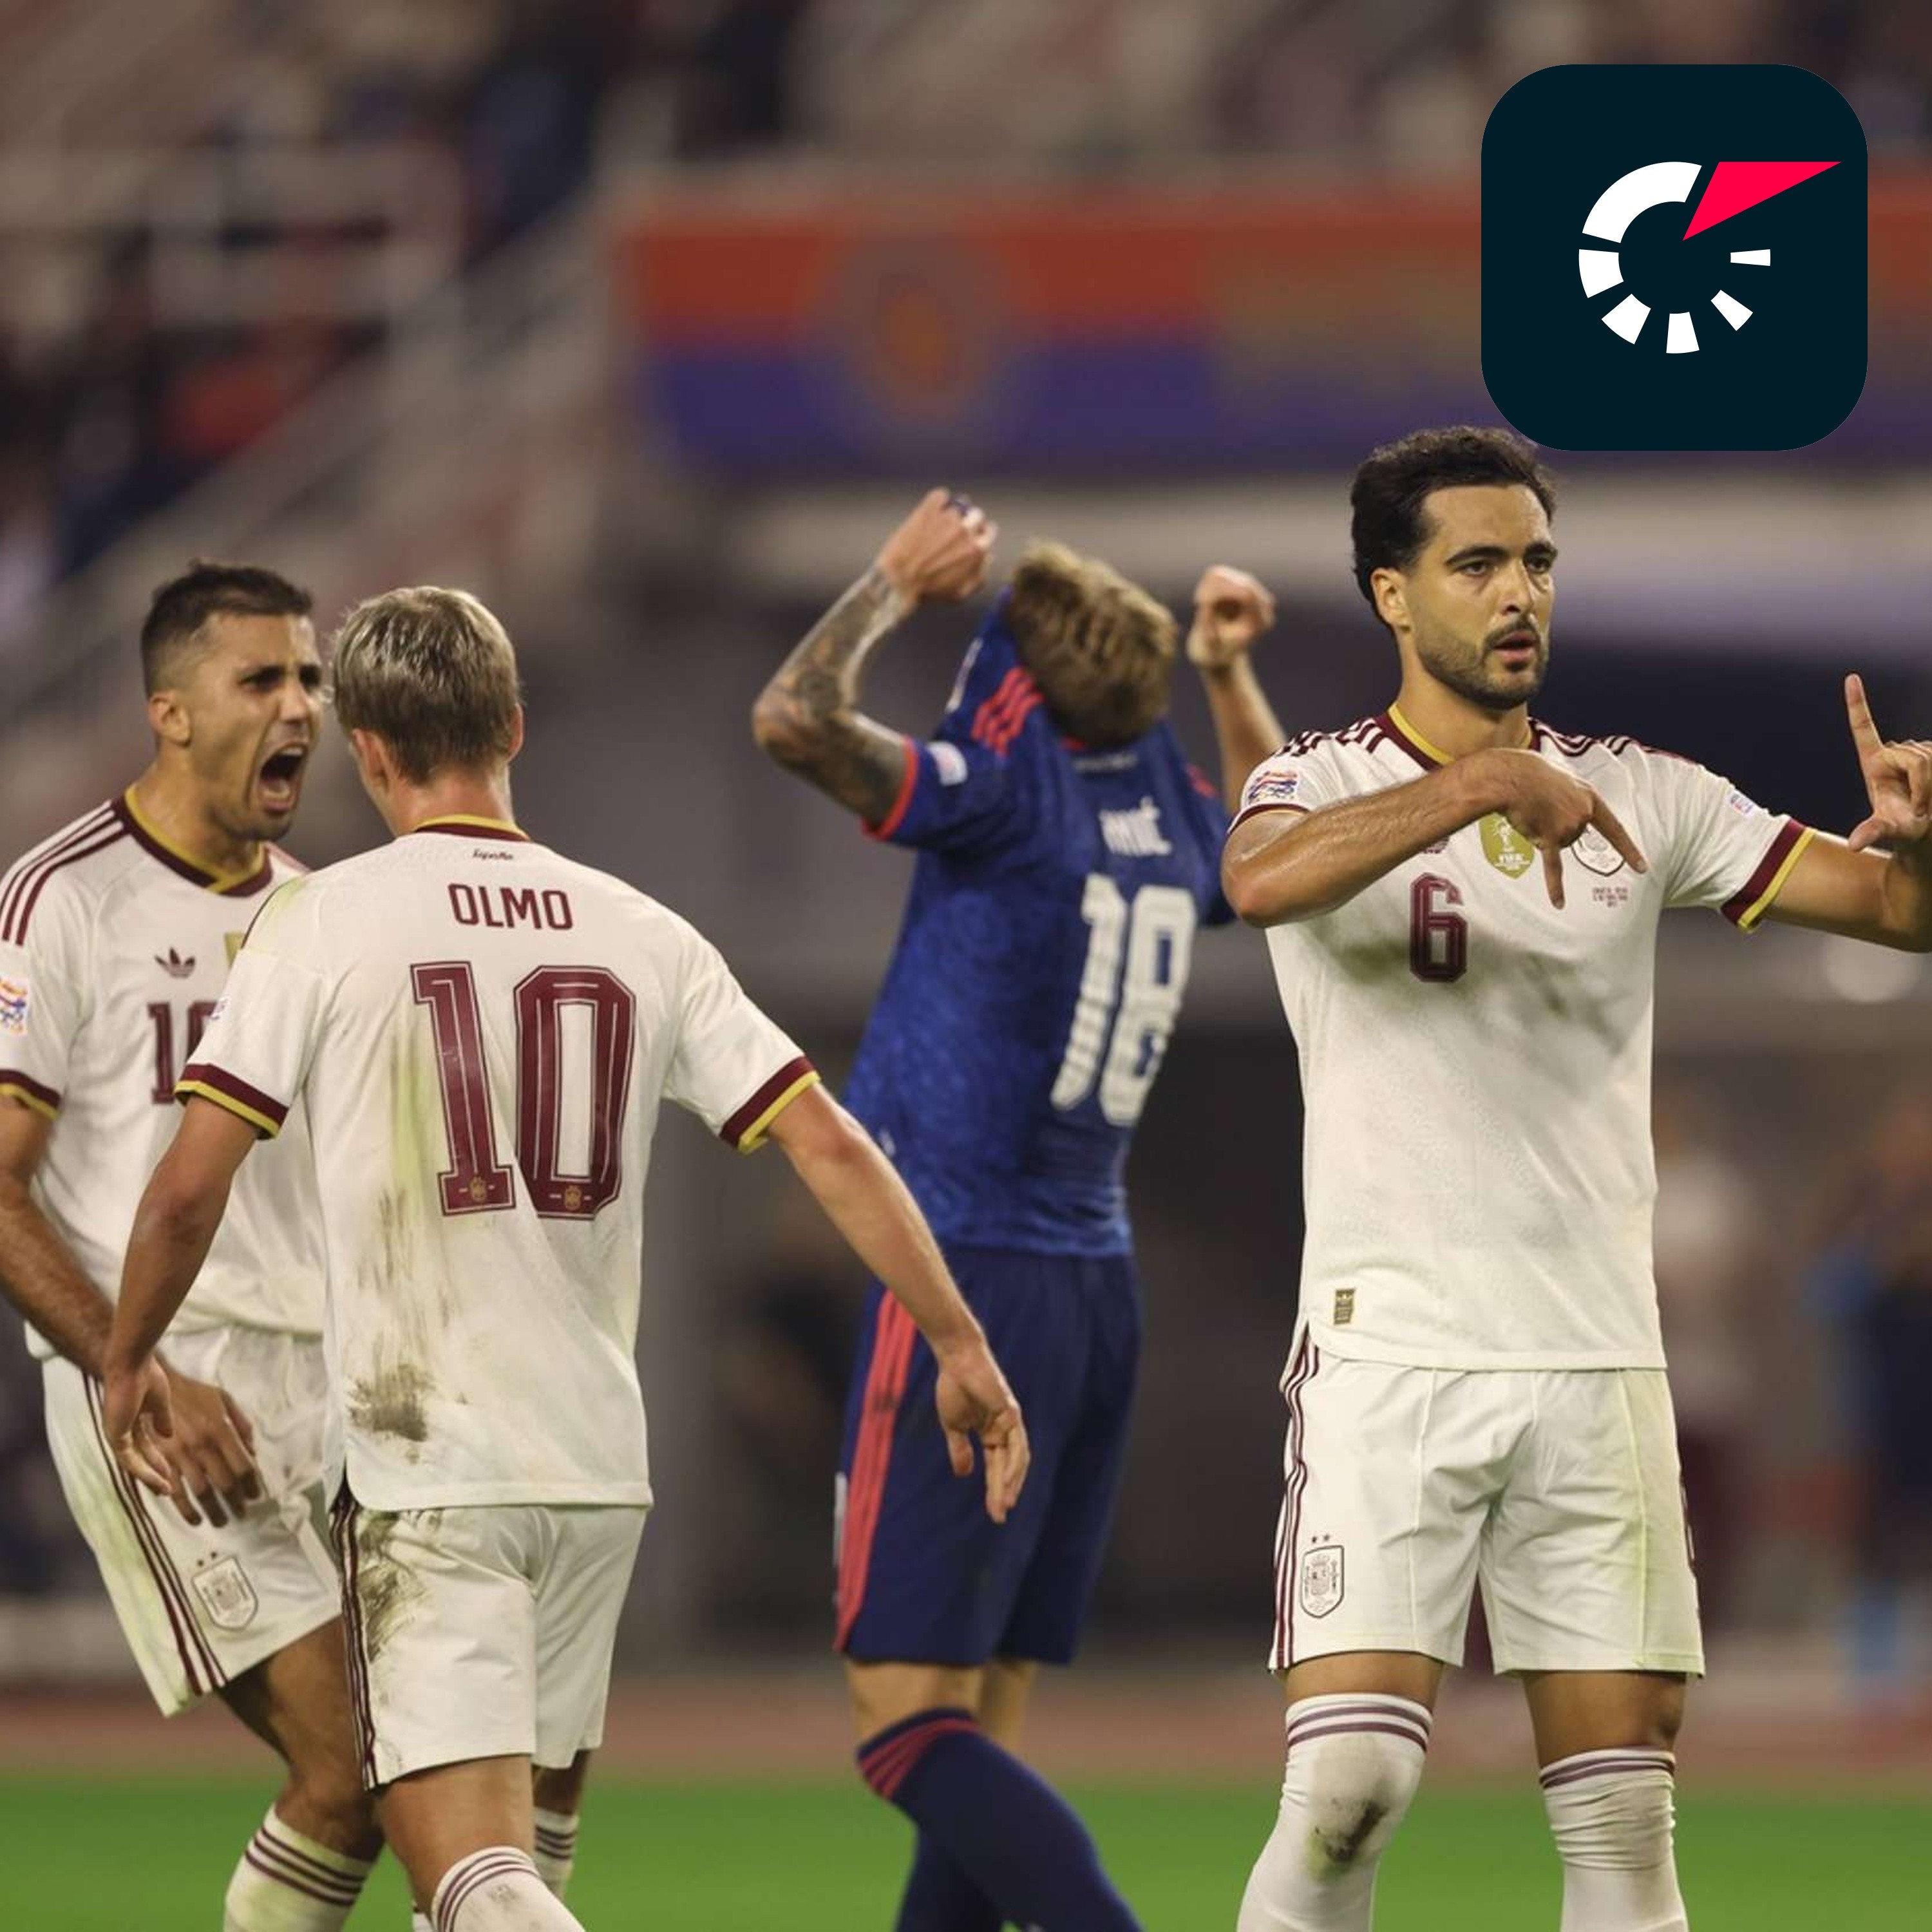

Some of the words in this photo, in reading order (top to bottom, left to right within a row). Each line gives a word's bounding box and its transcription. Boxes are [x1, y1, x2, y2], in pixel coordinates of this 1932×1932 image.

[448, 884, 573, 929] OLMO
[1409, 873, 1467, 982] 6
[1050, 873, 1197, 1125] 18
[410, 961, 636, 1220] 10
